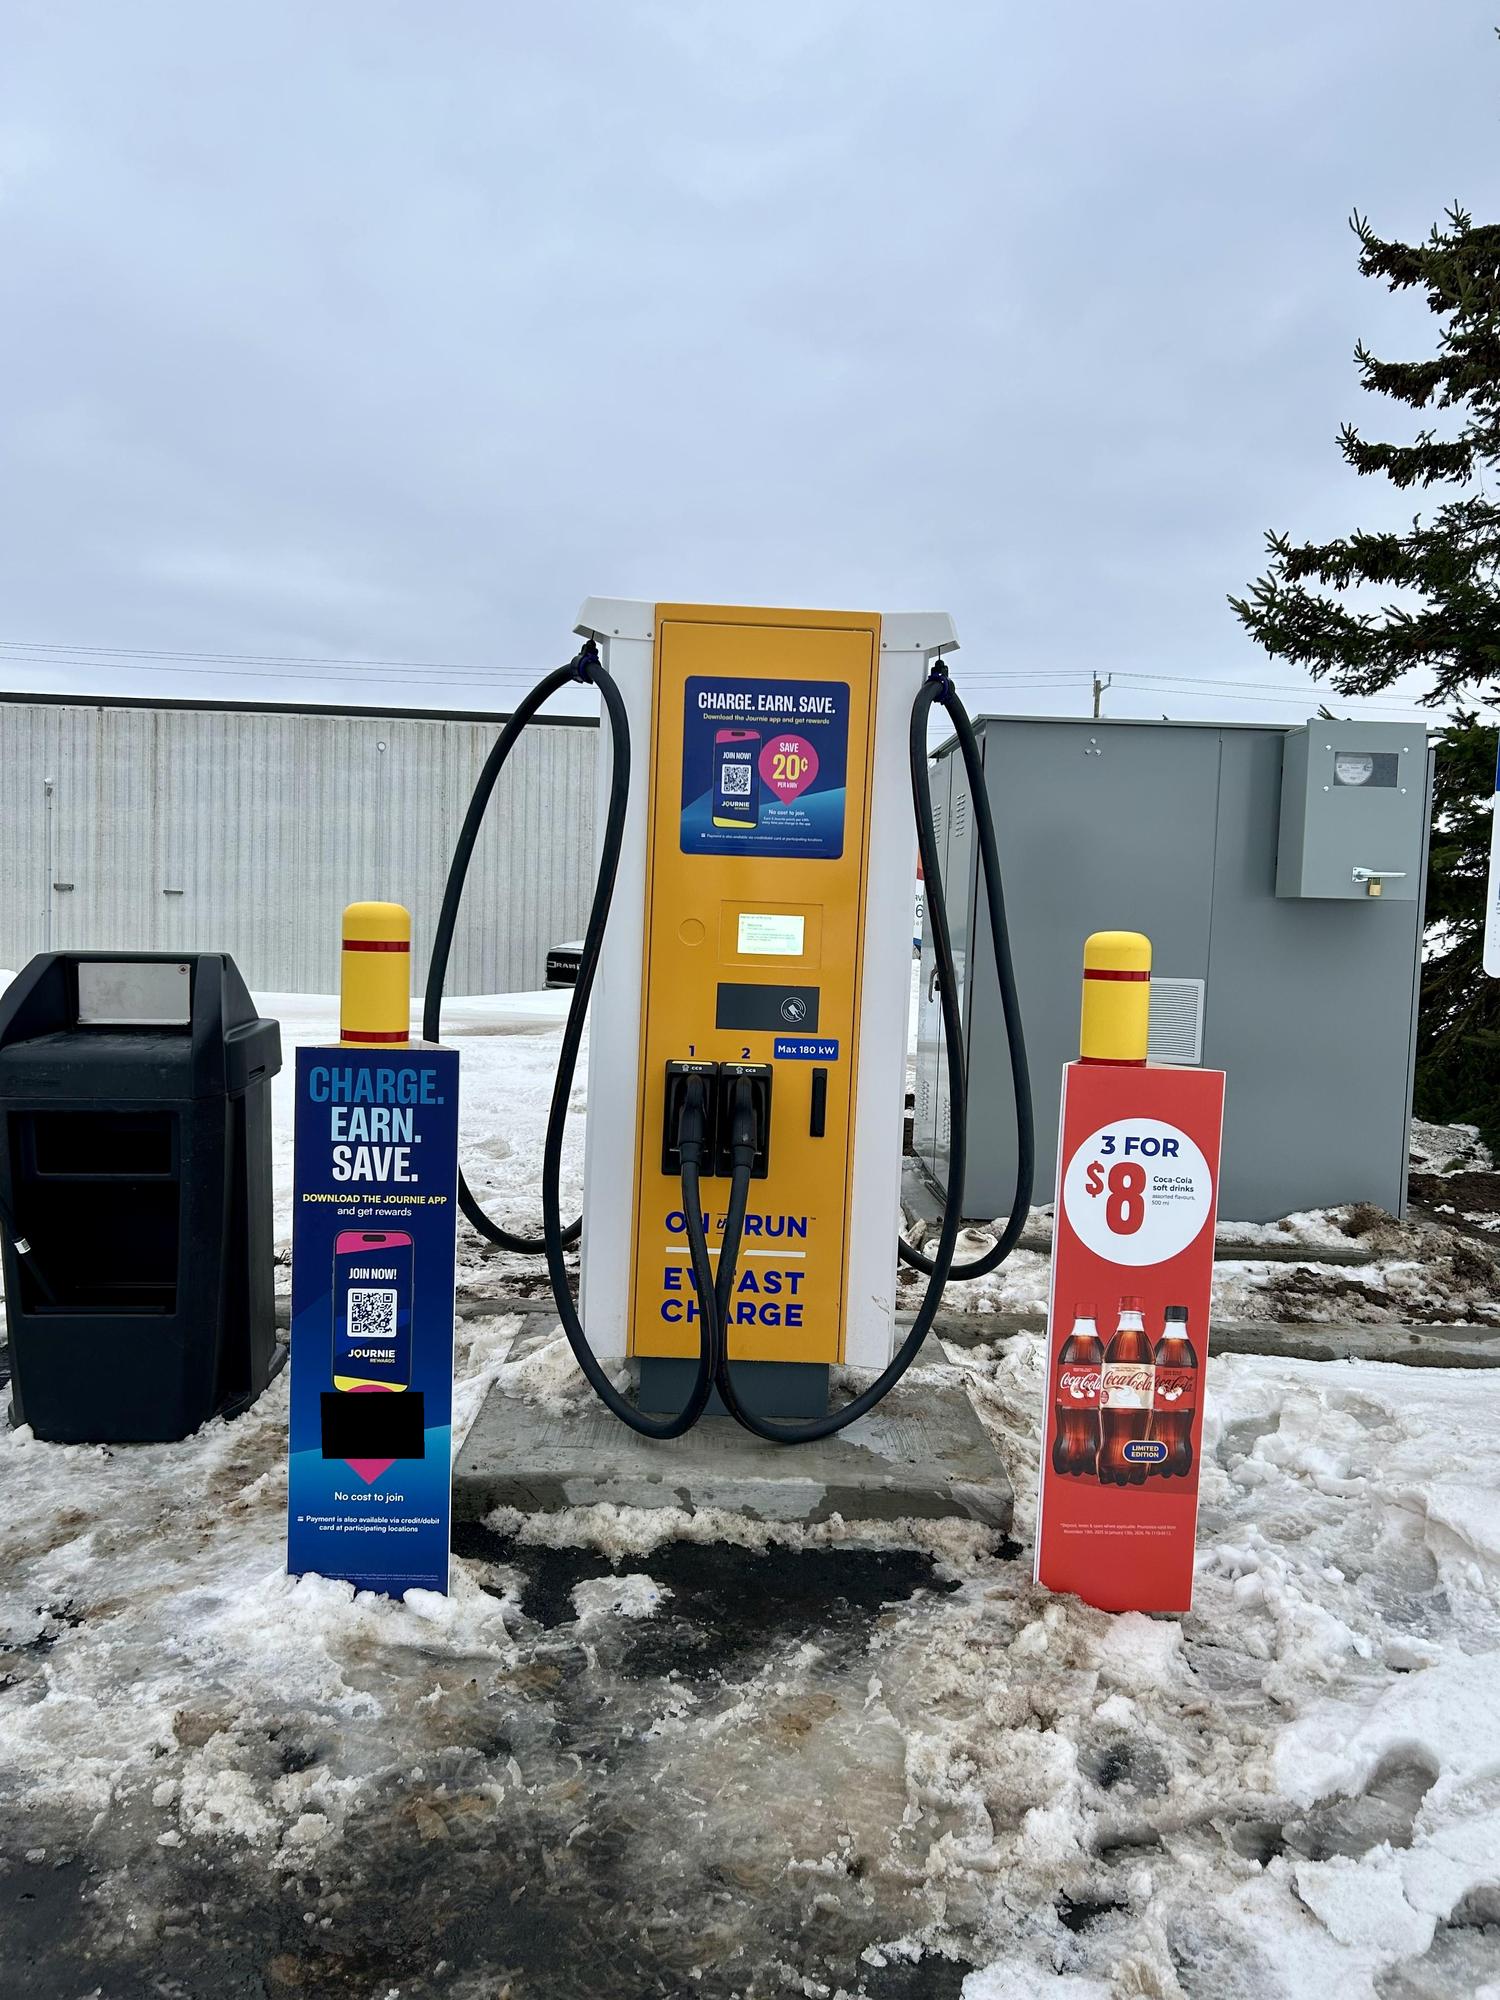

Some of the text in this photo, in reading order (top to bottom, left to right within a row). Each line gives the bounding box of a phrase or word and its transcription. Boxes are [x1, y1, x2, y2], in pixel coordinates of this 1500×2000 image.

[698, 692, 836, 714] CHARGE. EARN. SAVE.
[703, 713, 734, 721] Download
[794, 717, 805, 725] get
[805, 717, 830, 725] rewards
[779, 742, 799, 752] SAVE
[735, 752, 752, 760] NOW!
[772, 754, 808, 780] 20¢
[688, 1045, 695, 1057] 1
[741, 1047, 751, 1059] 2
[778, 1045, 835, 1055] Max 180 kW
[309, 1066, 444, 1105] CHARGE.
[331, 1106, 422, 1143] EARN.
[1100, 1135, 1180, 1158] 3 FOR
[332, 1145, 419, 1182] SAVE.
[1153, 1175, 1193, 1184] Coca-Cola
[1169, 1184, 1194, 1192] drinks
[303, 1193, 447, 1205] DOWNLOAD THE JOURNIE APP
[1085, 1160, 1147, 1236] $8
[337, 1206, 412, 1217] and get rewards
[348, 1267, 397, 1280] JOIN NOW!
[732, 1270, 805, 1295] AST
[660, 1299, 804, 1327] CHRGE
[348, 1349, 396, 1359] JOURNIE
[1103, 1371, 1153, 1391] Coca-Cola
[334, 1491, 404, 1504] No cost to join
[306, 1515, 336, 1524] Payment
[389, 1516, 400, 1524] via
[343, 1525, 387, 1534] participating
[388, 1525, 419, 1533] locations
